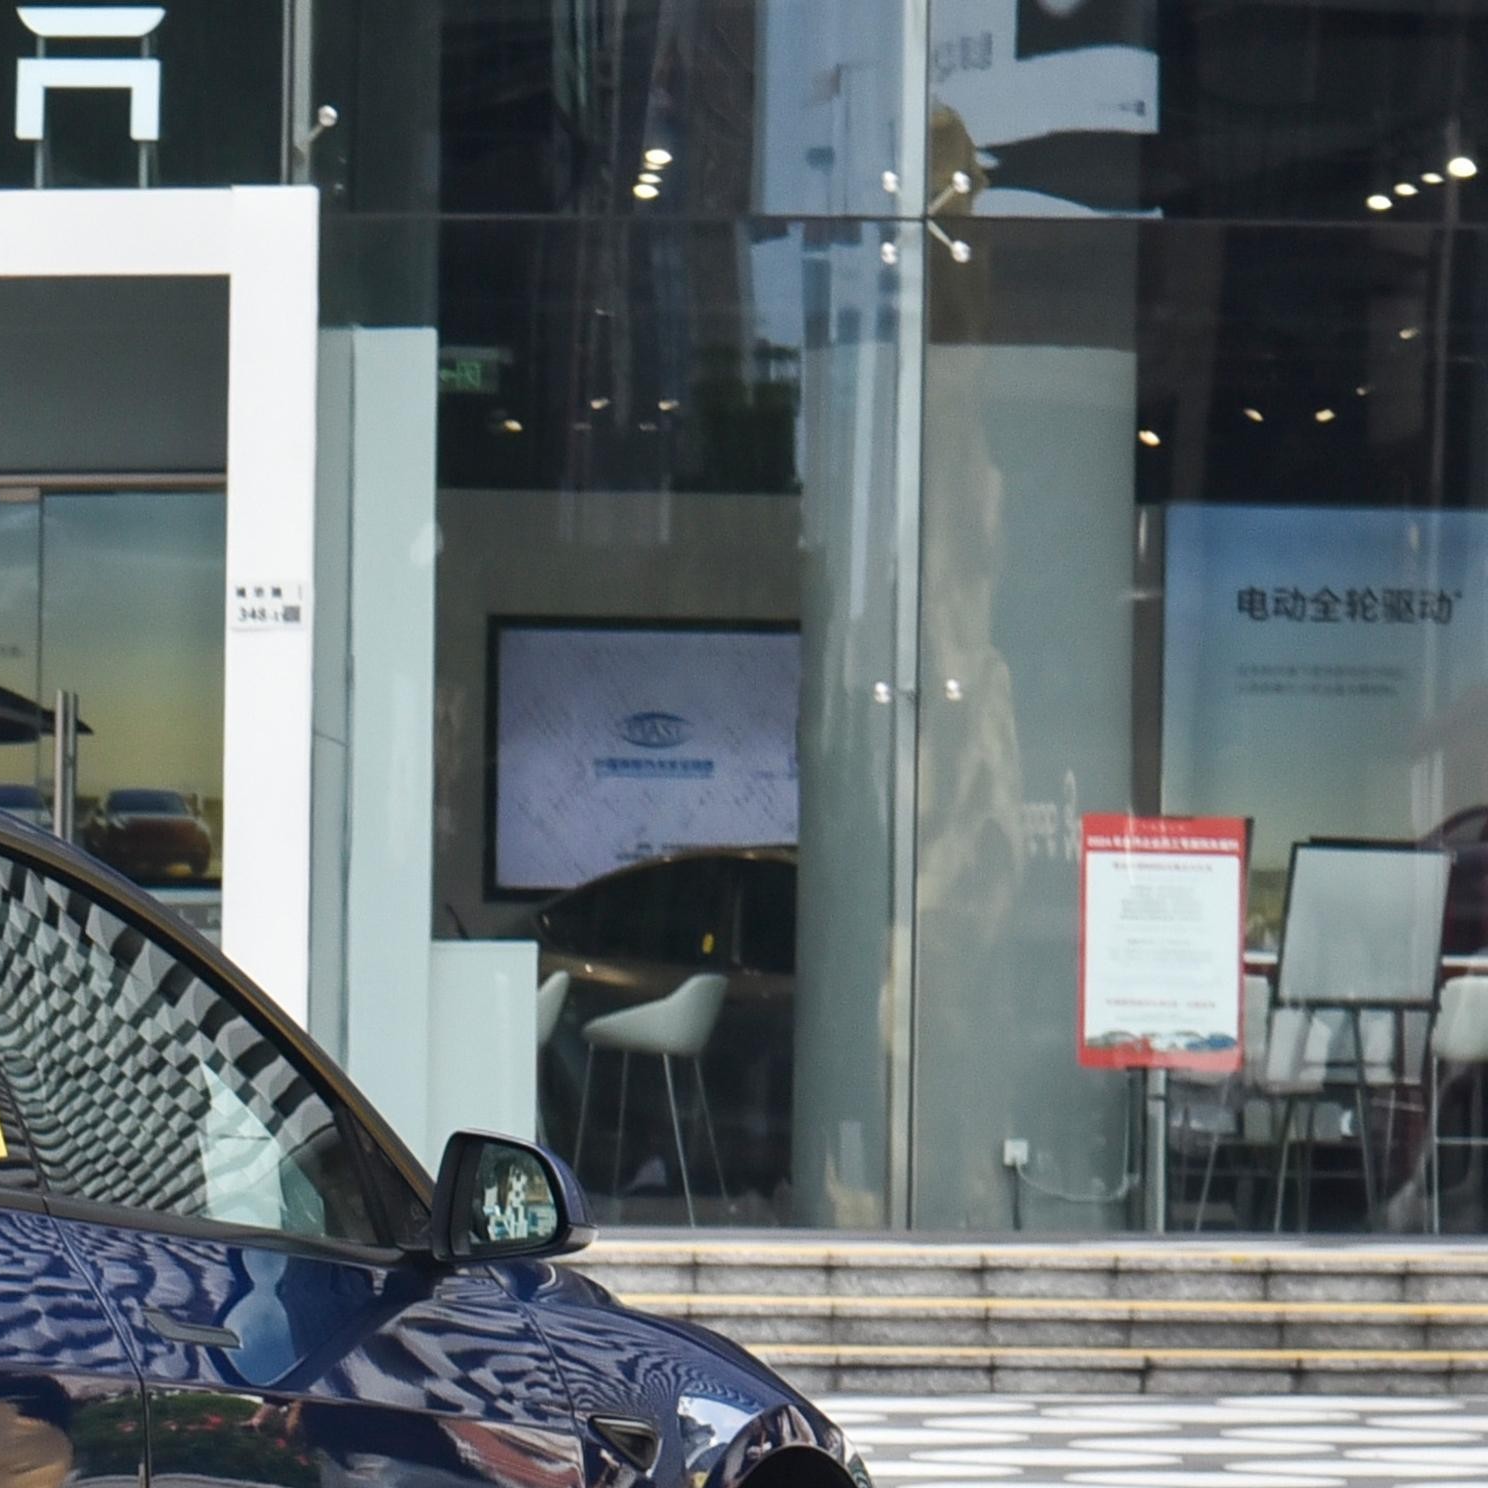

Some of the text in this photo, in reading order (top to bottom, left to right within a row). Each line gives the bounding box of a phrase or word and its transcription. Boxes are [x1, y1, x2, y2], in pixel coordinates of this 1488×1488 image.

[1237, 585, 1454, 625] 电动全轮驱动
